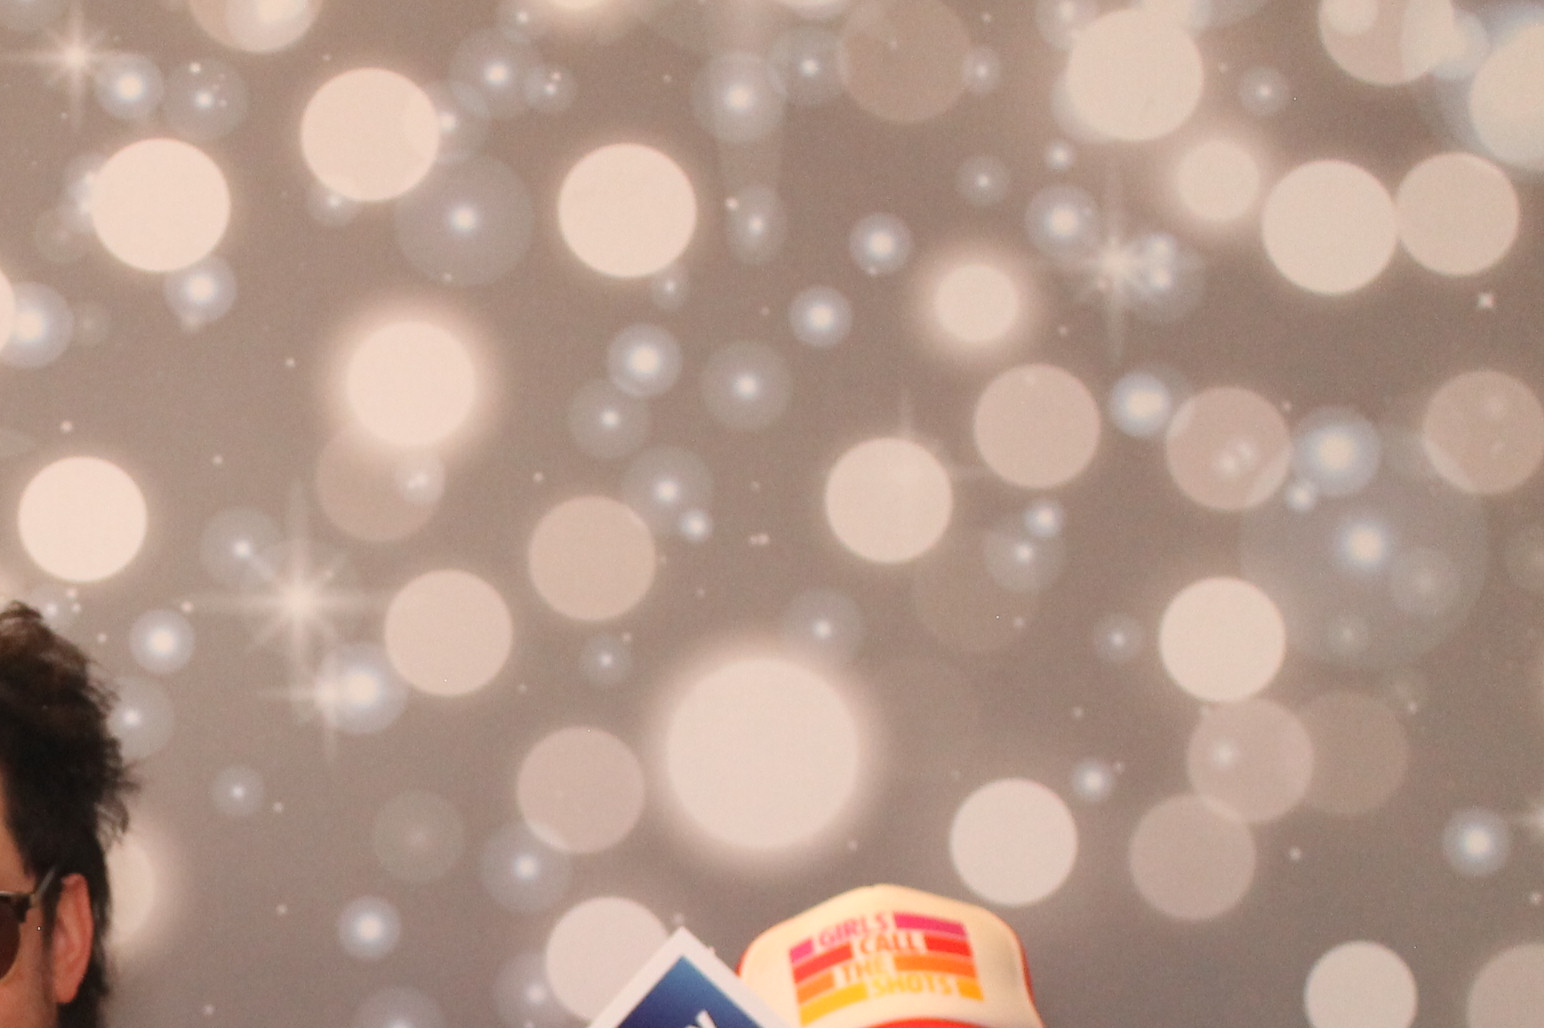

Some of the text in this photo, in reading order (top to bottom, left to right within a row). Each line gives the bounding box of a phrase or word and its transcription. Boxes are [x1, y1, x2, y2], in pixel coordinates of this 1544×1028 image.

[817, 911, 890, 949] GIRLS
[859, 932, 919, 954] CALL
[840, 956, 888, 984] THE
[871, 974, 953, 998] SHOTS
